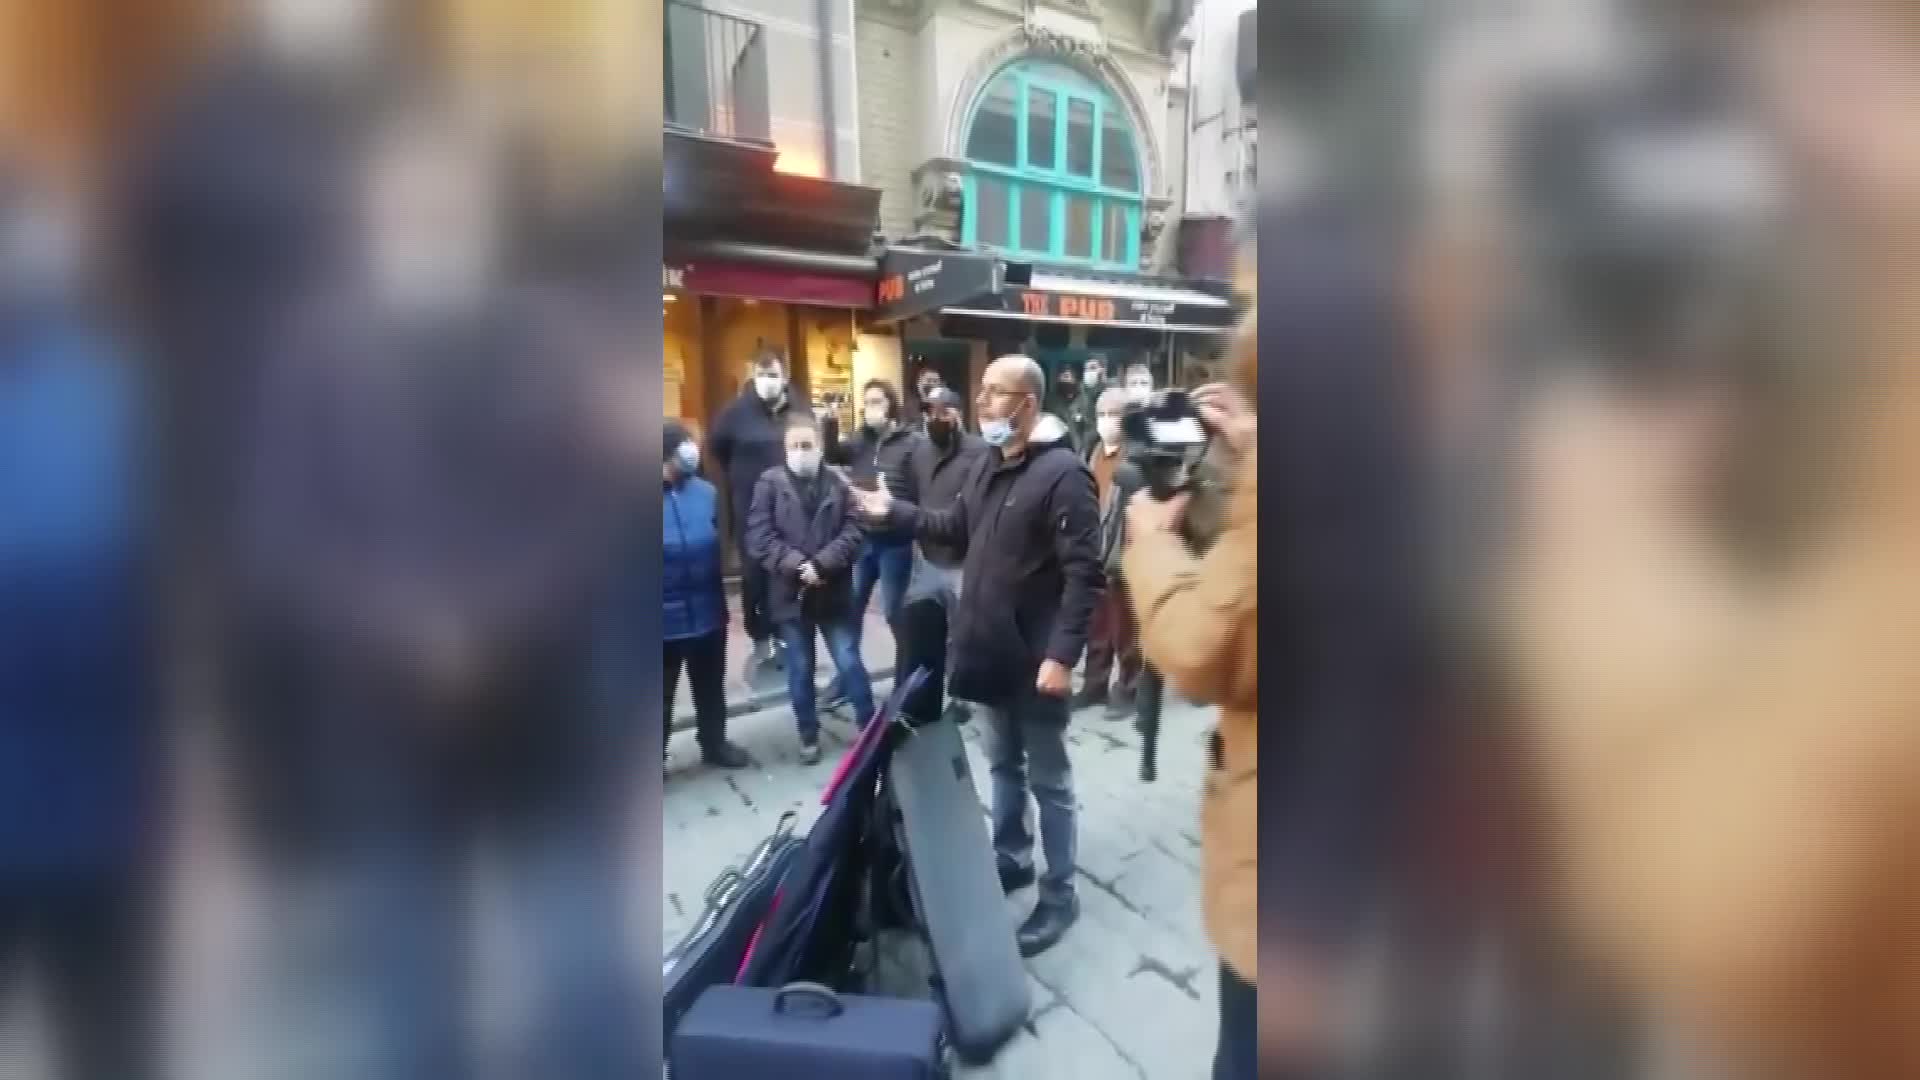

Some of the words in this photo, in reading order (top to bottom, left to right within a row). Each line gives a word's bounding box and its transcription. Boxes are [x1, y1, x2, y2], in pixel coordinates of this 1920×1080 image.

[879, 274, 904, 304] PUB
[1022, 293, 1048, 315] THE
[1058, 296, 1115, 320] PUB
